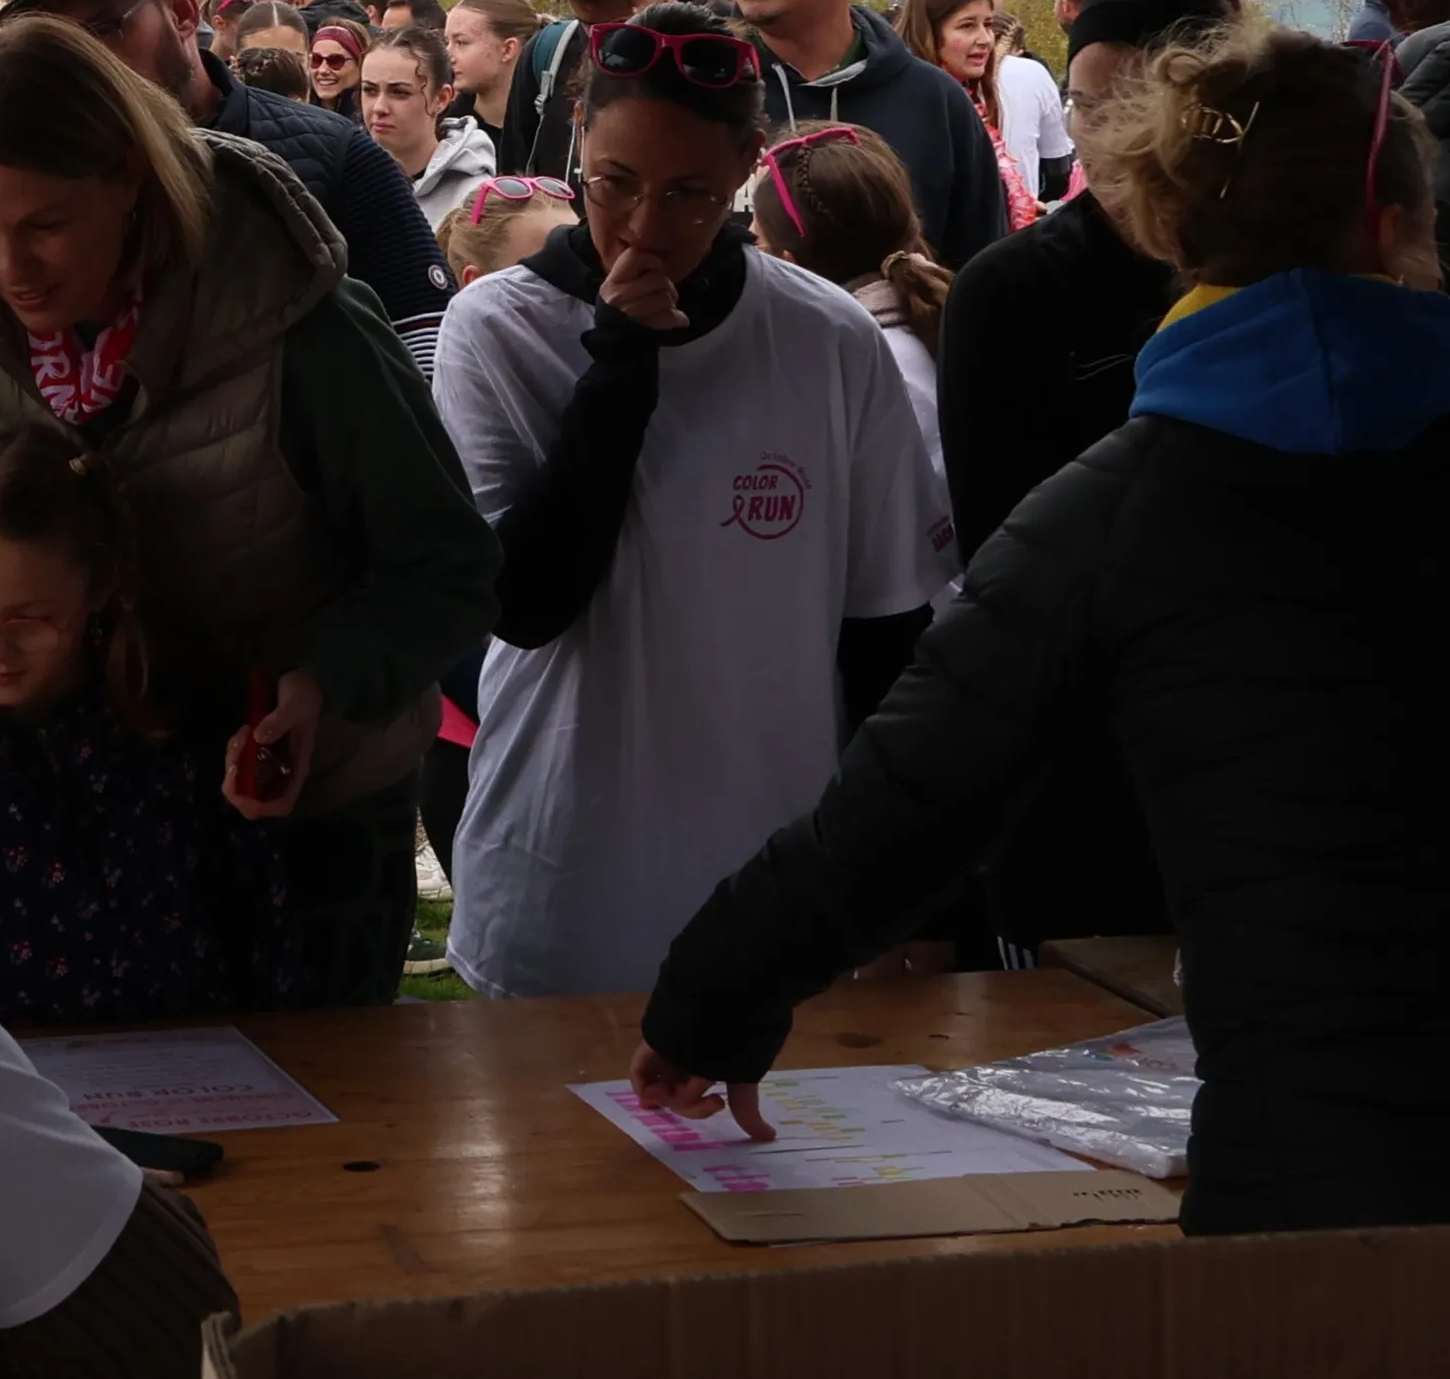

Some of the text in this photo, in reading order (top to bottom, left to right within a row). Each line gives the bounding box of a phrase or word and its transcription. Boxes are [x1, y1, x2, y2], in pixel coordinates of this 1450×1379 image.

[734, 475, 777, 489] COLOR
[748, 496, 795, 521] RUN
[150, 1084, 254, 1097] COLOR
